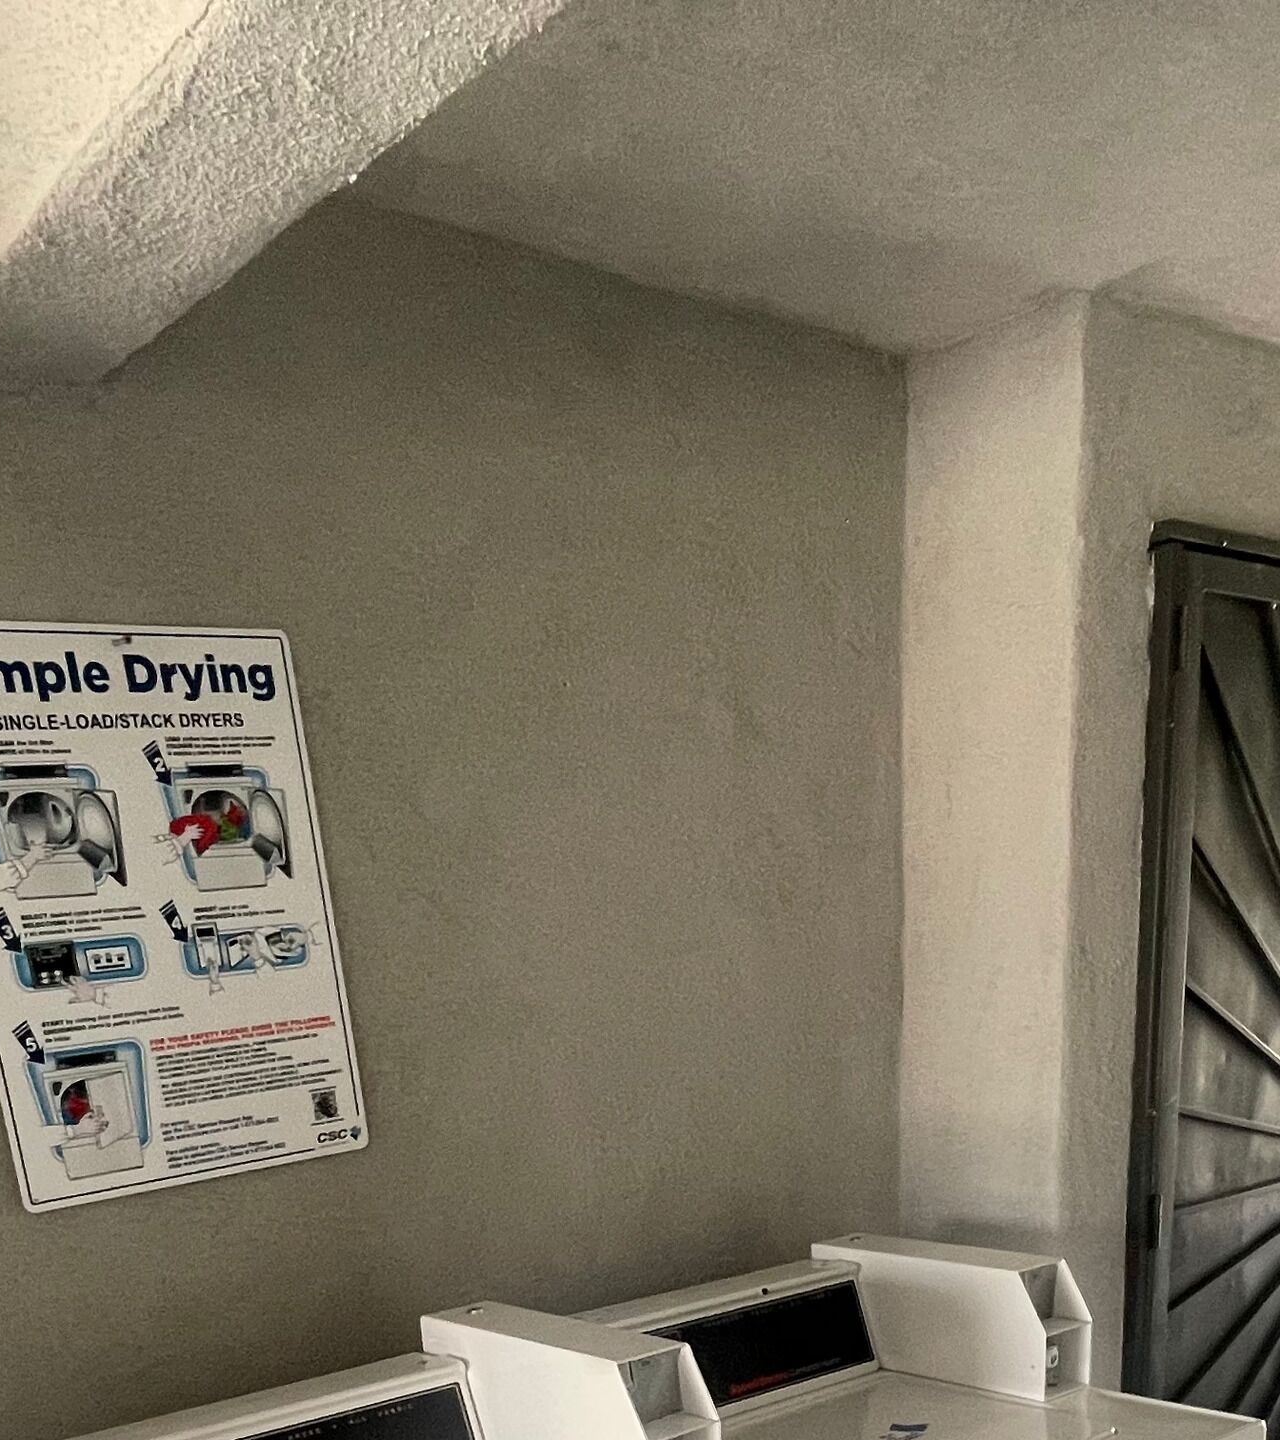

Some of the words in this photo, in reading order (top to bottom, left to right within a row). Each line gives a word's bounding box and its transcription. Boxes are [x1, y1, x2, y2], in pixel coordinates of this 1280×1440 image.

[122, 653, 276, 702] Drying
[179, 712, 245, 729] DRYERS
[153, 757, 166, 772] 2
[0, 924, 14, 940] 3
[25, 1038, 37, 1052] 5
[316, 1127, 348, 1144] CSC
